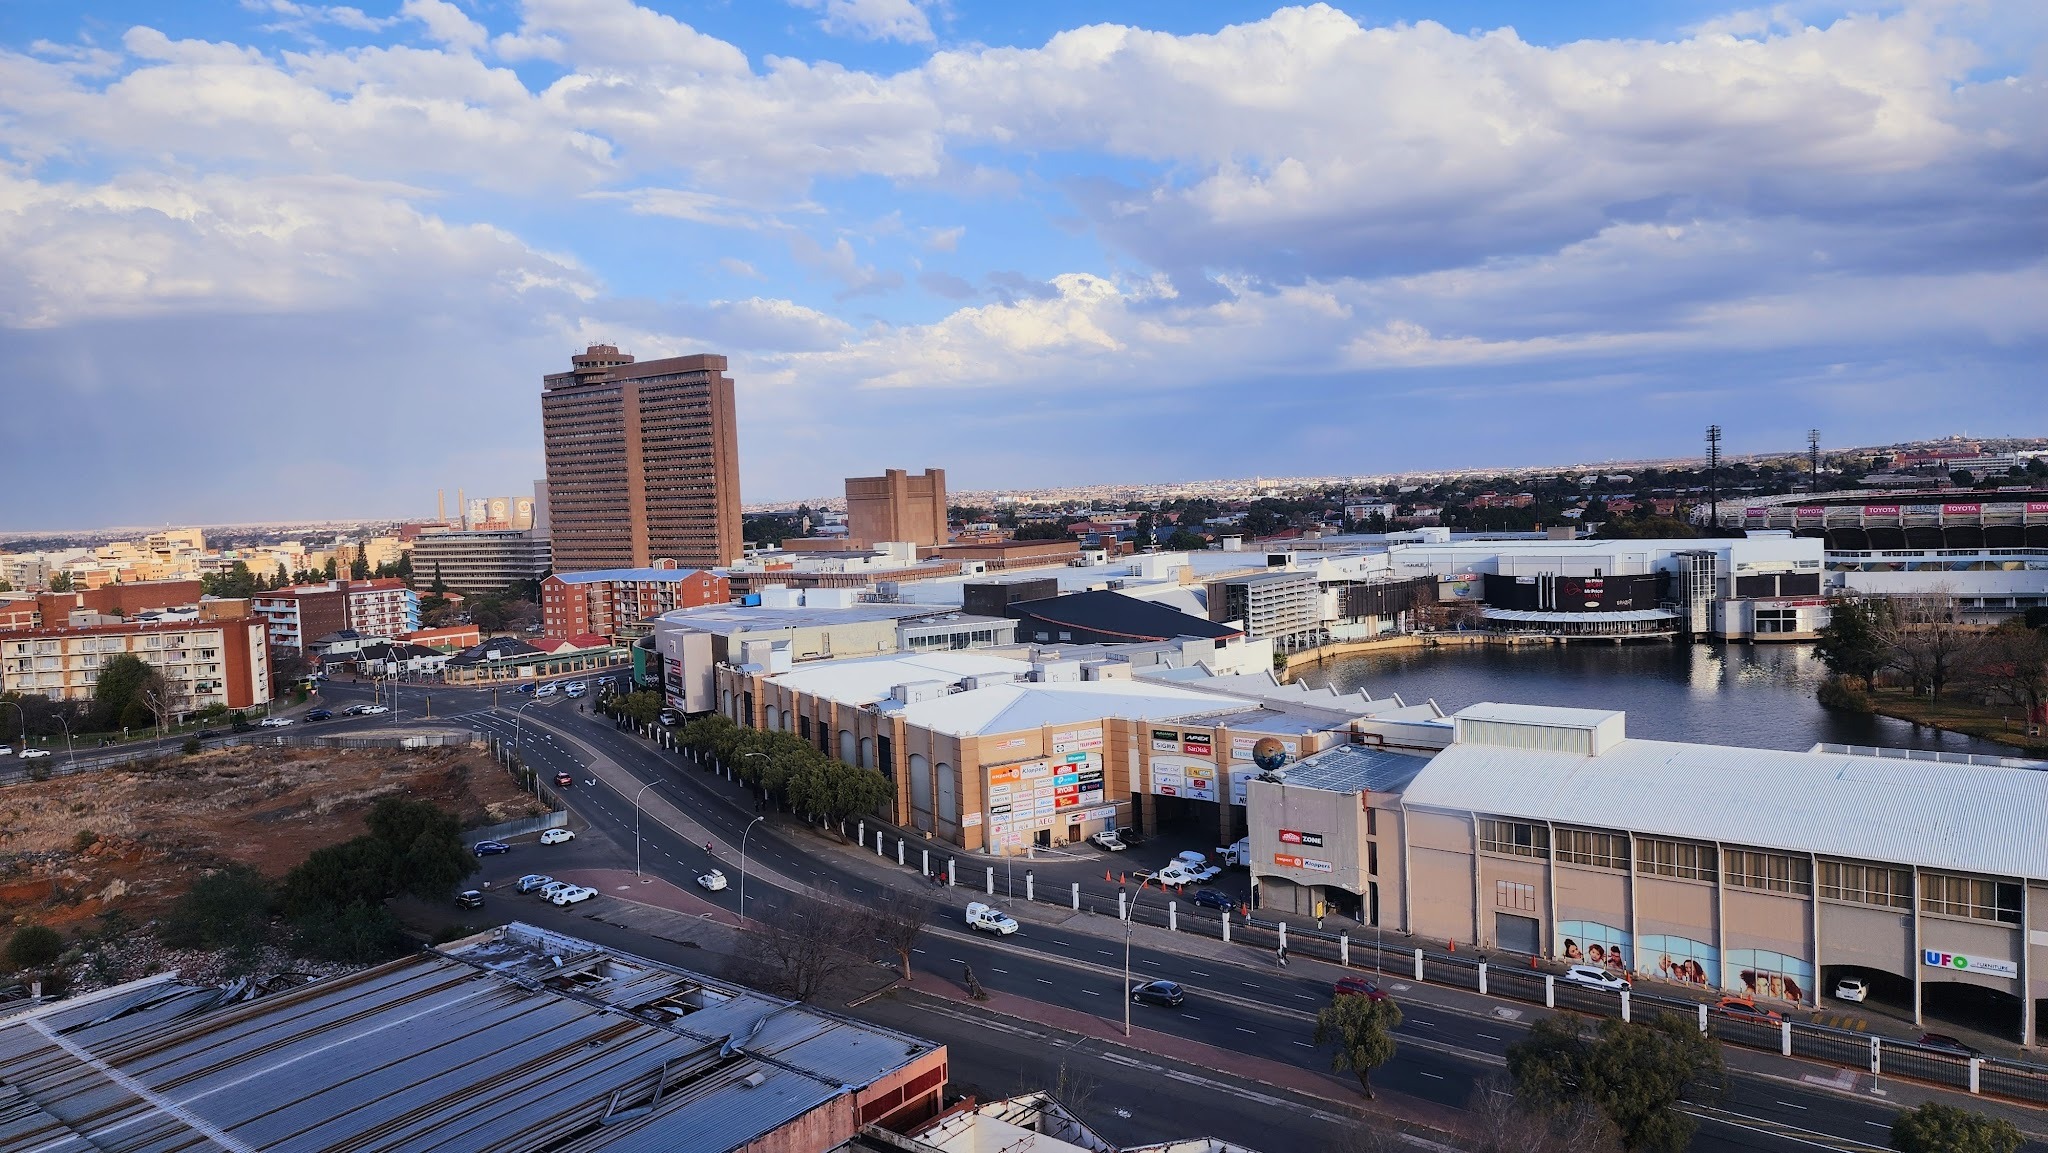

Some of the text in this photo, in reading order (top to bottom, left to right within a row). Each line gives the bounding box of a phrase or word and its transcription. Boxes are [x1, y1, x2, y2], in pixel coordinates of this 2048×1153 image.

[1187, 745, 1209, 753] SanDisk
[1039, 817, 1053, 825] AEG
[1302, 835, 1322, 844] ZONE
[1304, 860, 1330, 869] Kloppers
[1926, 951, 1968, 969] UFO
